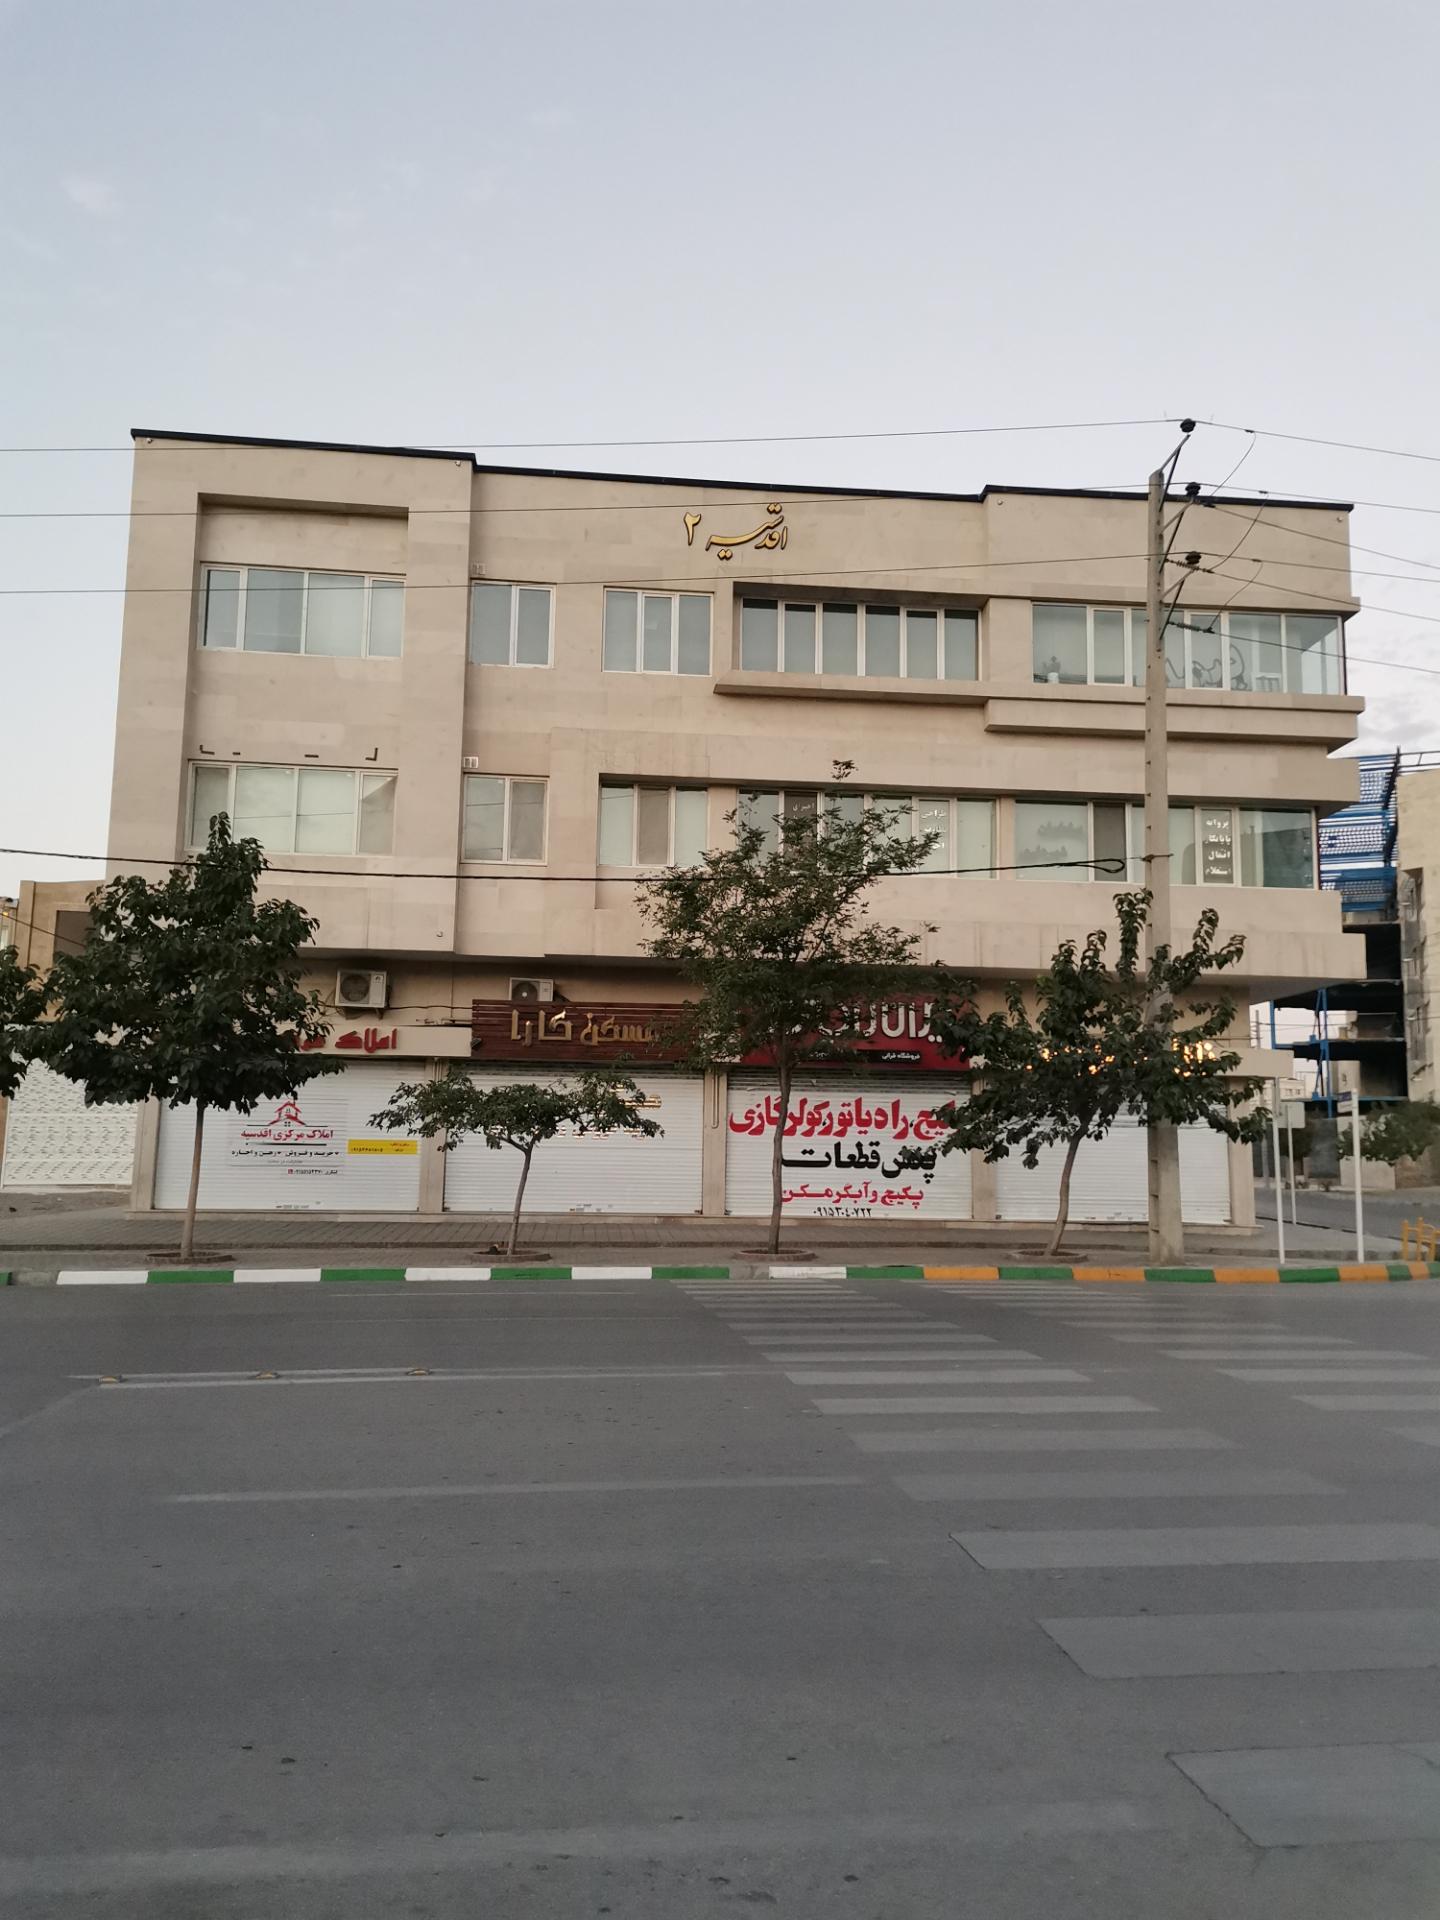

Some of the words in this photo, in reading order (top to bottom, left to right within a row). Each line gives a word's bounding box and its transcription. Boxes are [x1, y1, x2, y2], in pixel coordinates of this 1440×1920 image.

[683, 511, 702, 546] ۲
[705, 503, 788, 560] اقدسیه
[334, 1027, 398, 1054] املاک
[780, 1141, 881, 1169] قطعات
[880, 1185, 924, 1209] پکیج
